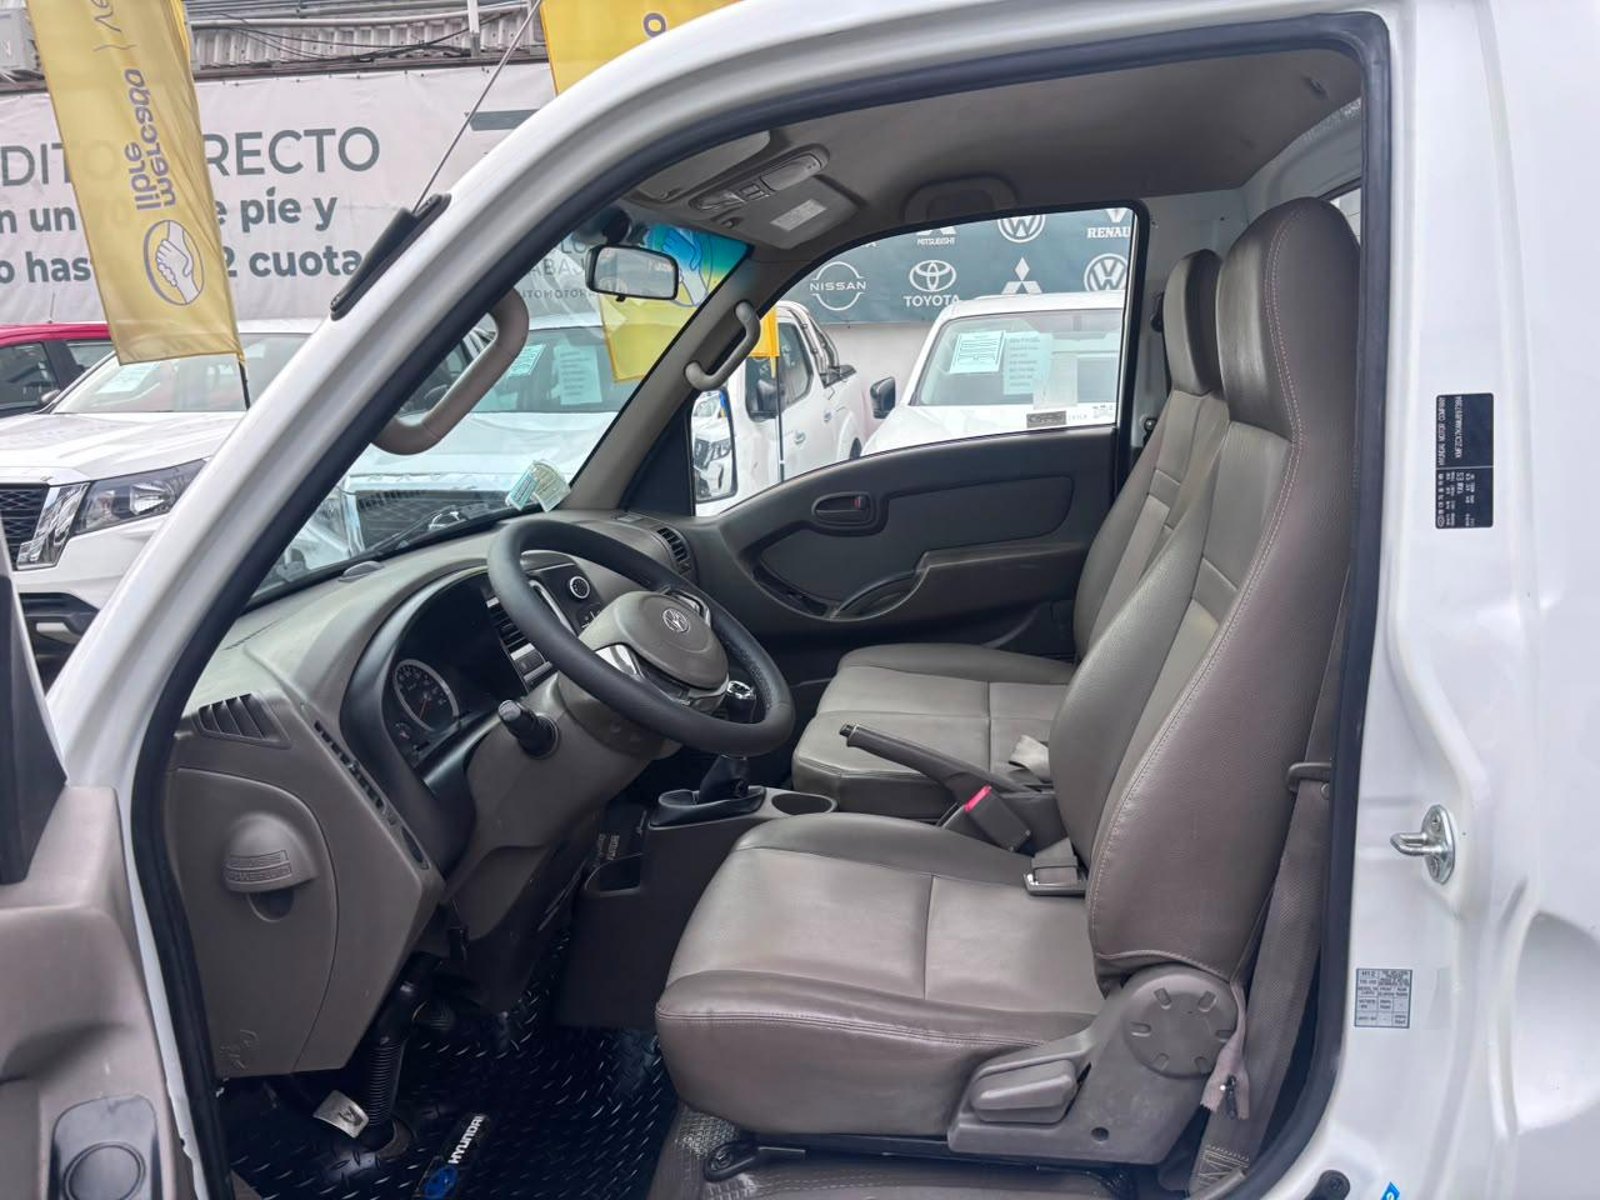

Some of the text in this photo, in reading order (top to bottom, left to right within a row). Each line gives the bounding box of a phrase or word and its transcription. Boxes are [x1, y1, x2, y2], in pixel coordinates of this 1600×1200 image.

[29, 206, 77, 233] un
[312, 196, 339, 232] y
[809, 281, 867, 292] NISSAN
[903, 294, 961, 308] TOYOTA
[447, 1114, 485, 1164] HYUNDAI
